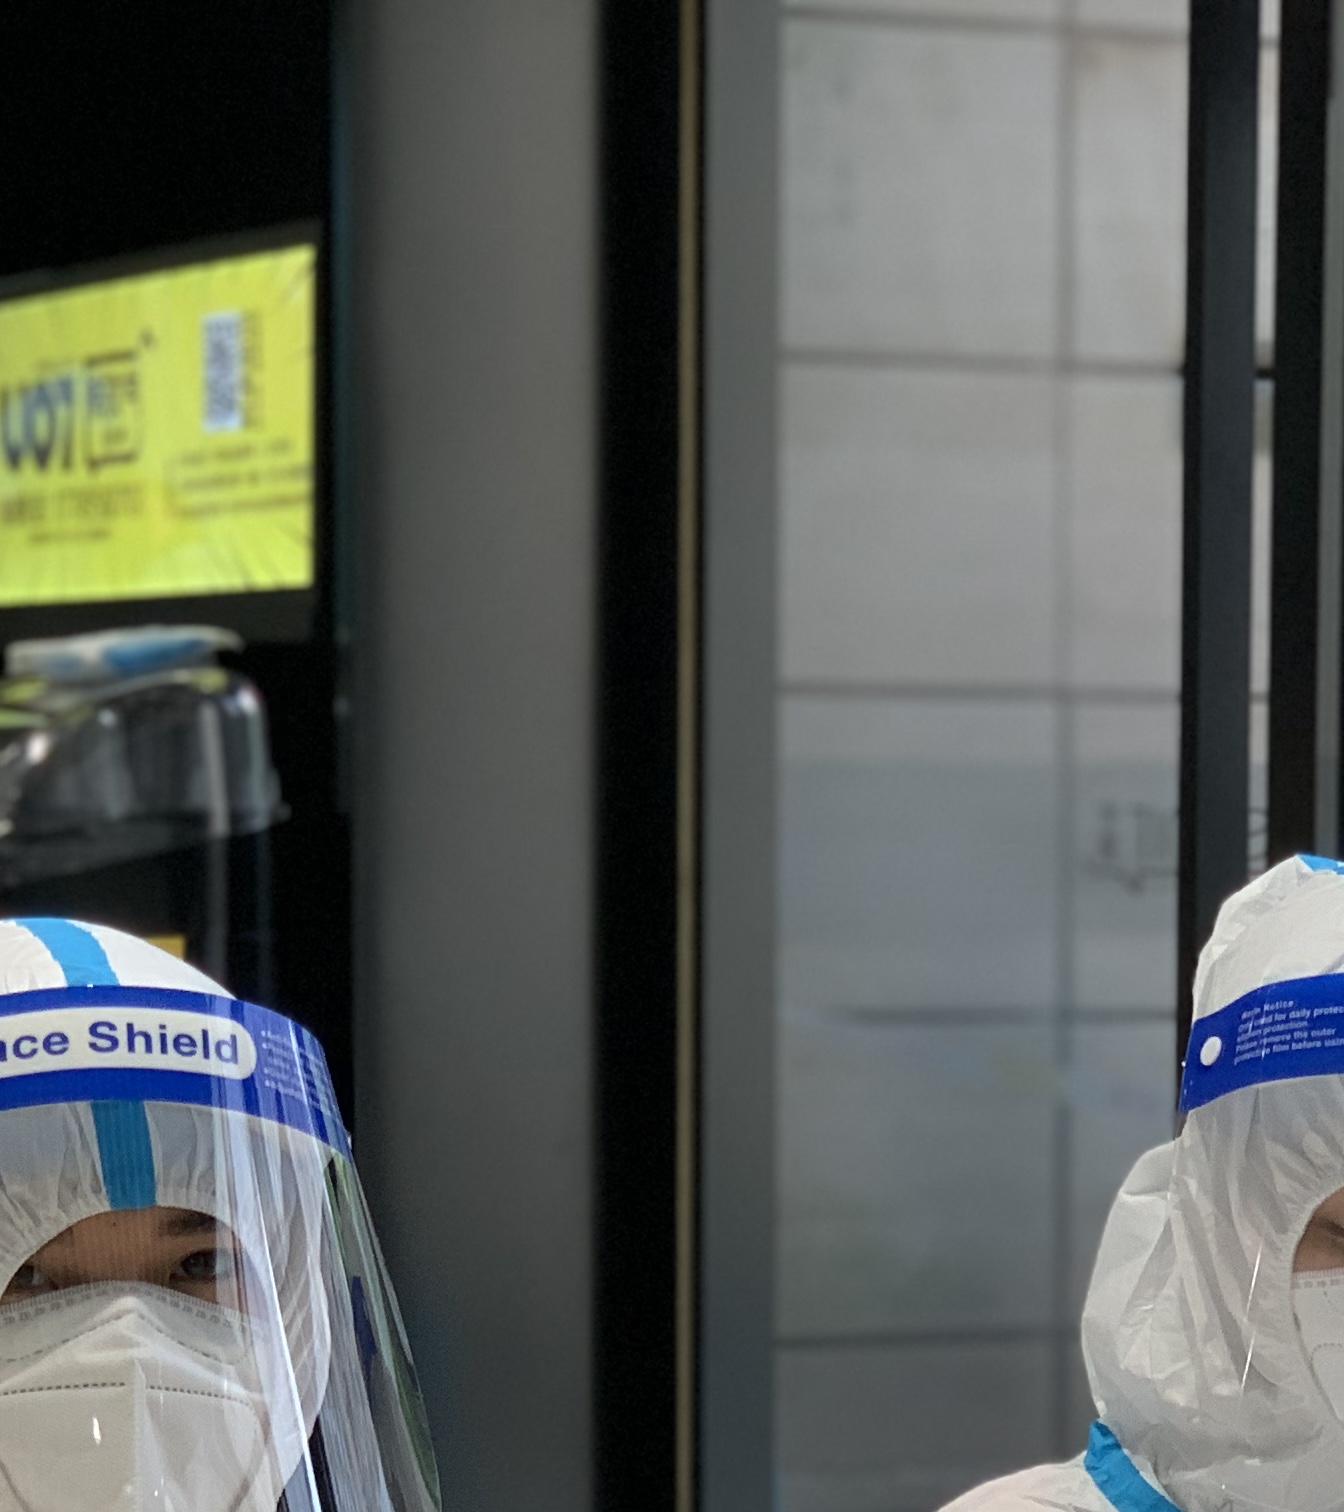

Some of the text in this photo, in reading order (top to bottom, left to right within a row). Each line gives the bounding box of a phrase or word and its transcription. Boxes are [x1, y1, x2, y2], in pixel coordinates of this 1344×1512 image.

[1288, 1008, 1311, 1019] daily
[88, 1020, 240, 1066] Shield
[1291, 1040, 1322, 1051] before
